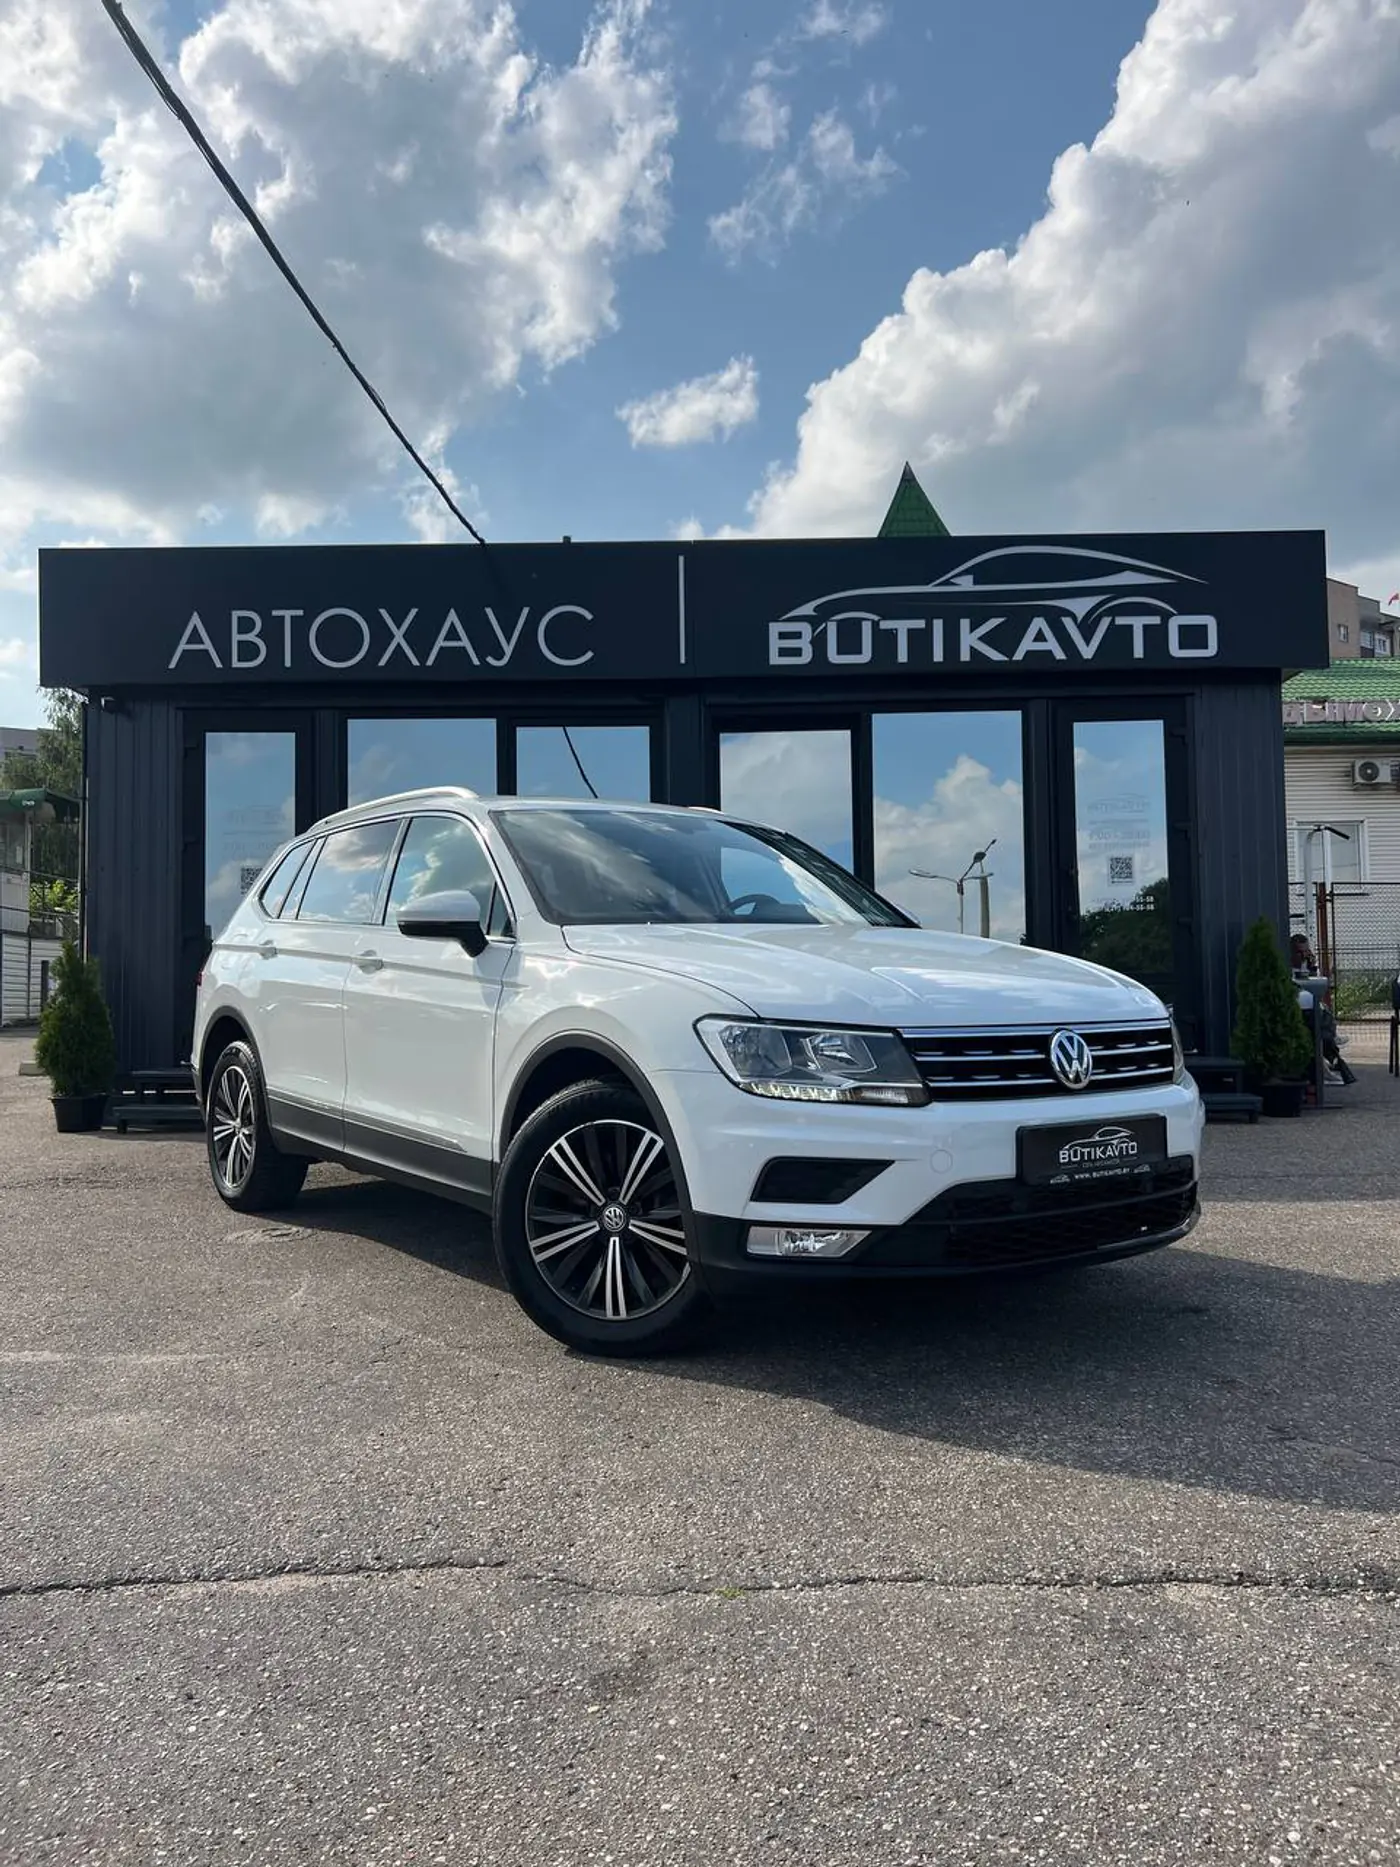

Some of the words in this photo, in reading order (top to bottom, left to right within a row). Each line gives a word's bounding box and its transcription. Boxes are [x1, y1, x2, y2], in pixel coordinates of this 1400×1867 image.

[168, 604, 595, 669] АВТОХАУС
[768, 614, 1219, 666] BUTIKAVTO
[1058, 1141, 1138, 1163] BUTIKAVTO
